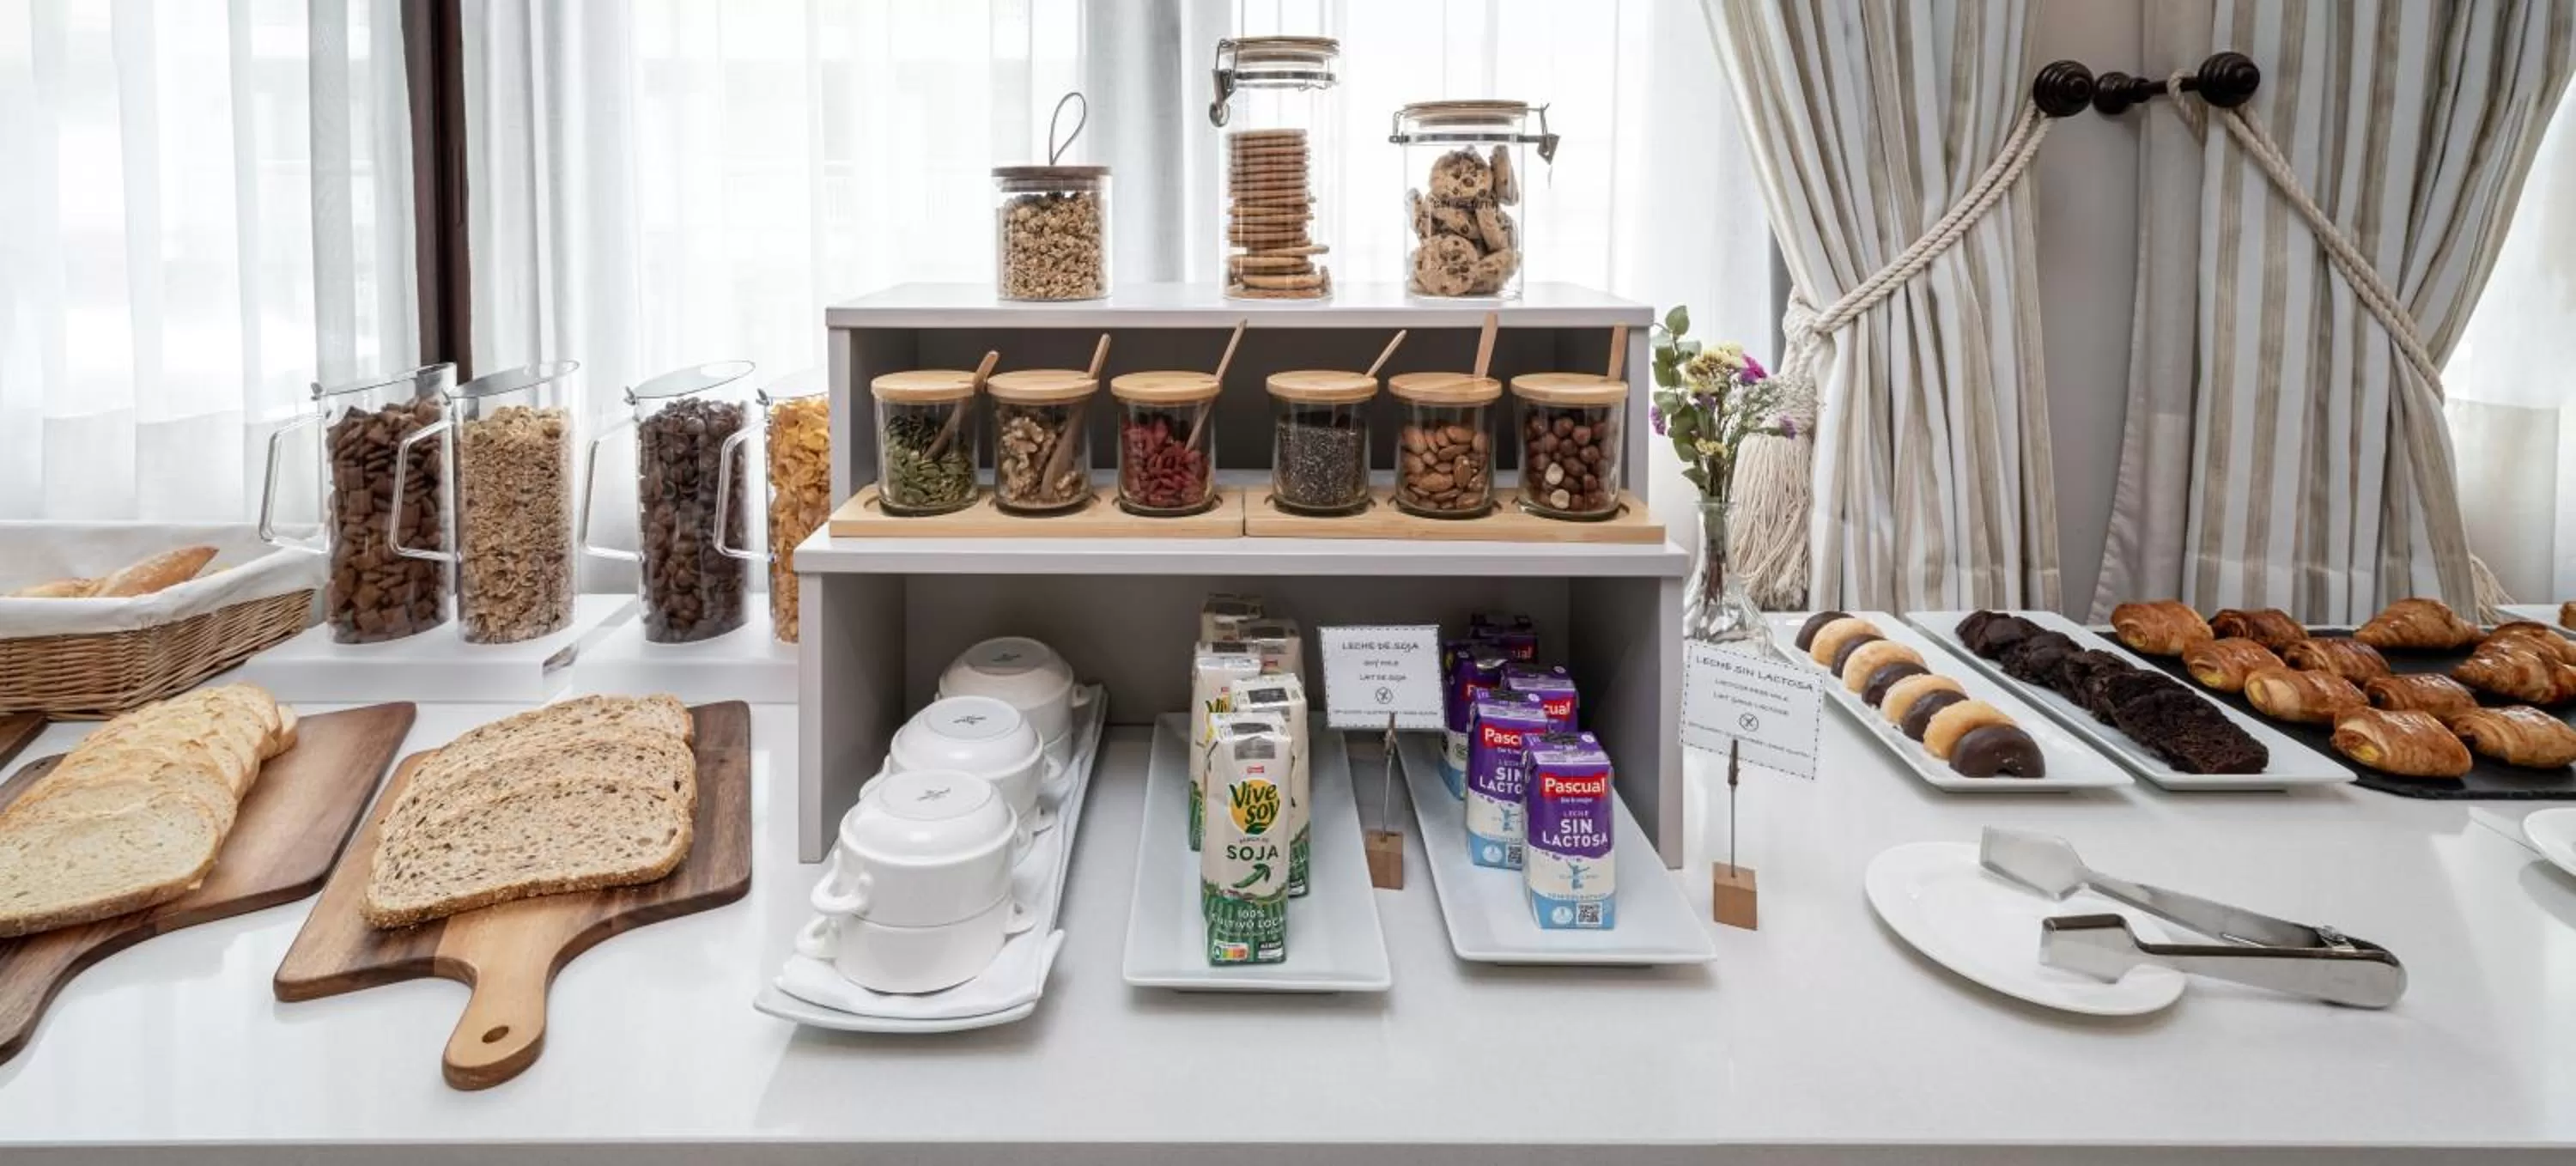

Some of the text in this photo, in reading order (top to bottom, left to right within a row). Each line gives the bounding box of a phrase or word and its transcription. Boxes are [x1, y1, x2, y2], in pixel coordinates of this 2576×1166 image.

[1342, 641, 1419, 653] LECHE DE SOJA
[1696, 655, 1814, 692] LECHE SIN LACTOSA
[1485, 727, 1522, 745] Pasc
[1479, 775, 1522, 794] LACTO
[1546, 777, 1606, 794] Pascual
[1229, 780, 1278, 809] Vive
[1245, 799, 1280, 826] soy
[1560, 818, 1593, 834] SIN
[1542, 830, 1608, 847] LACTOSA
[1226, 845, 1279, 860] SOJA
